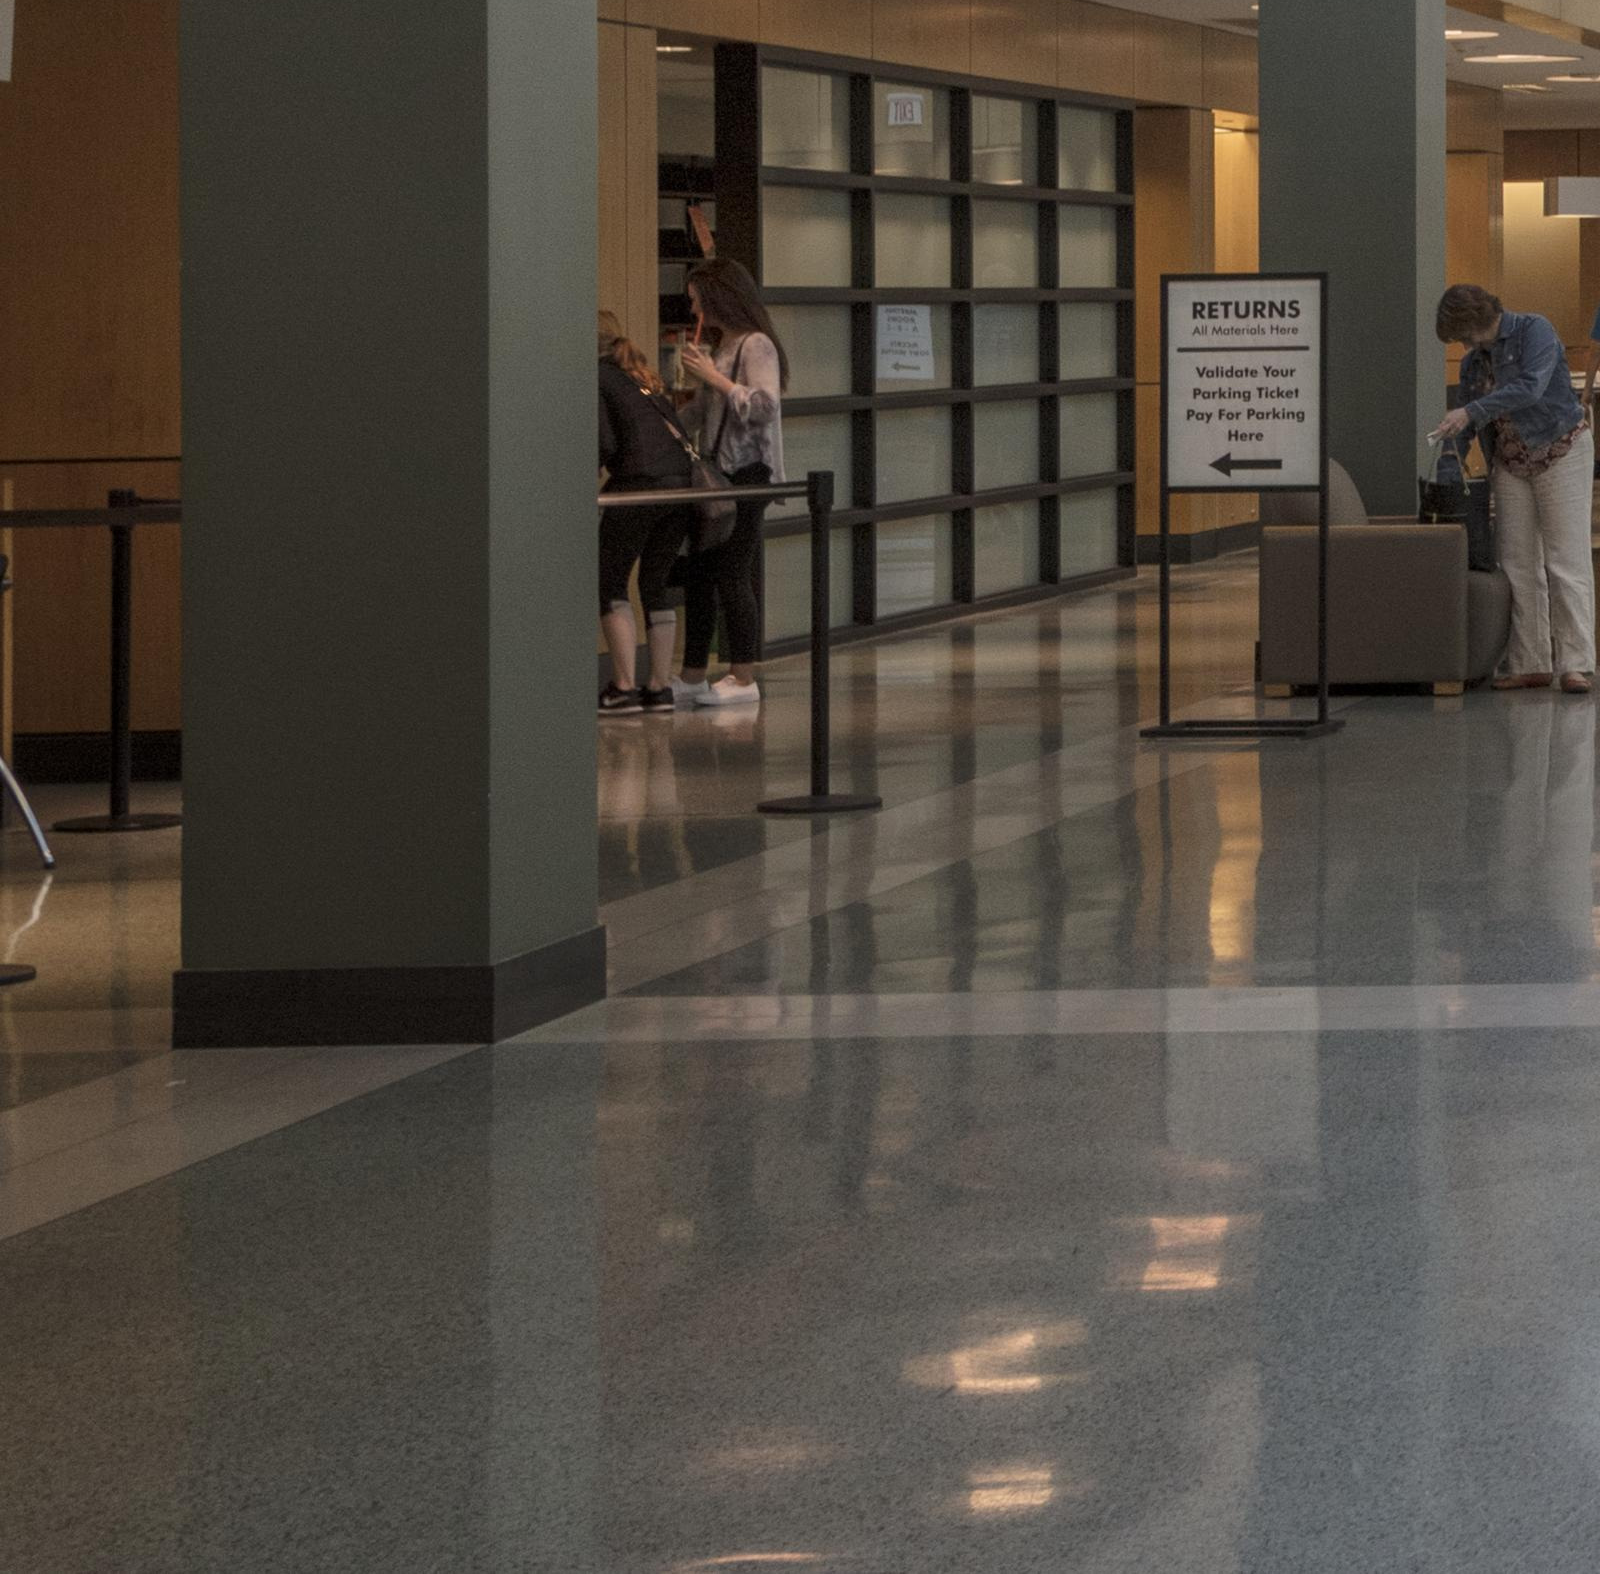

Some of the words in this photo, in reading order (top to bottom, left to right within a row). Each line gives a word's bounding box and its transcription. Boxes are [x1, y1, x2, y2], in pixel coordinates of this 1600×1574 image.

[1192, 301, 1300, 319] RETURNS
[1192, 325, 1208, 336] All
[1212, 324, 1266, 336] Materials
[1271, 324, 1299, 335] Here
[1196, 366, 1258, 378] Validate
[1262, 366, 1296, 378] Your
[1193, 387, 1251, 402] Parking
[1256, 387, 1299, 399] Ticket
[1187, 409, 1211, 423] Pay
[1218, 408, 1241, 420] For
[1247, 407, 1305, 422] Parking
[1227, 429, 1264, 441] Here
